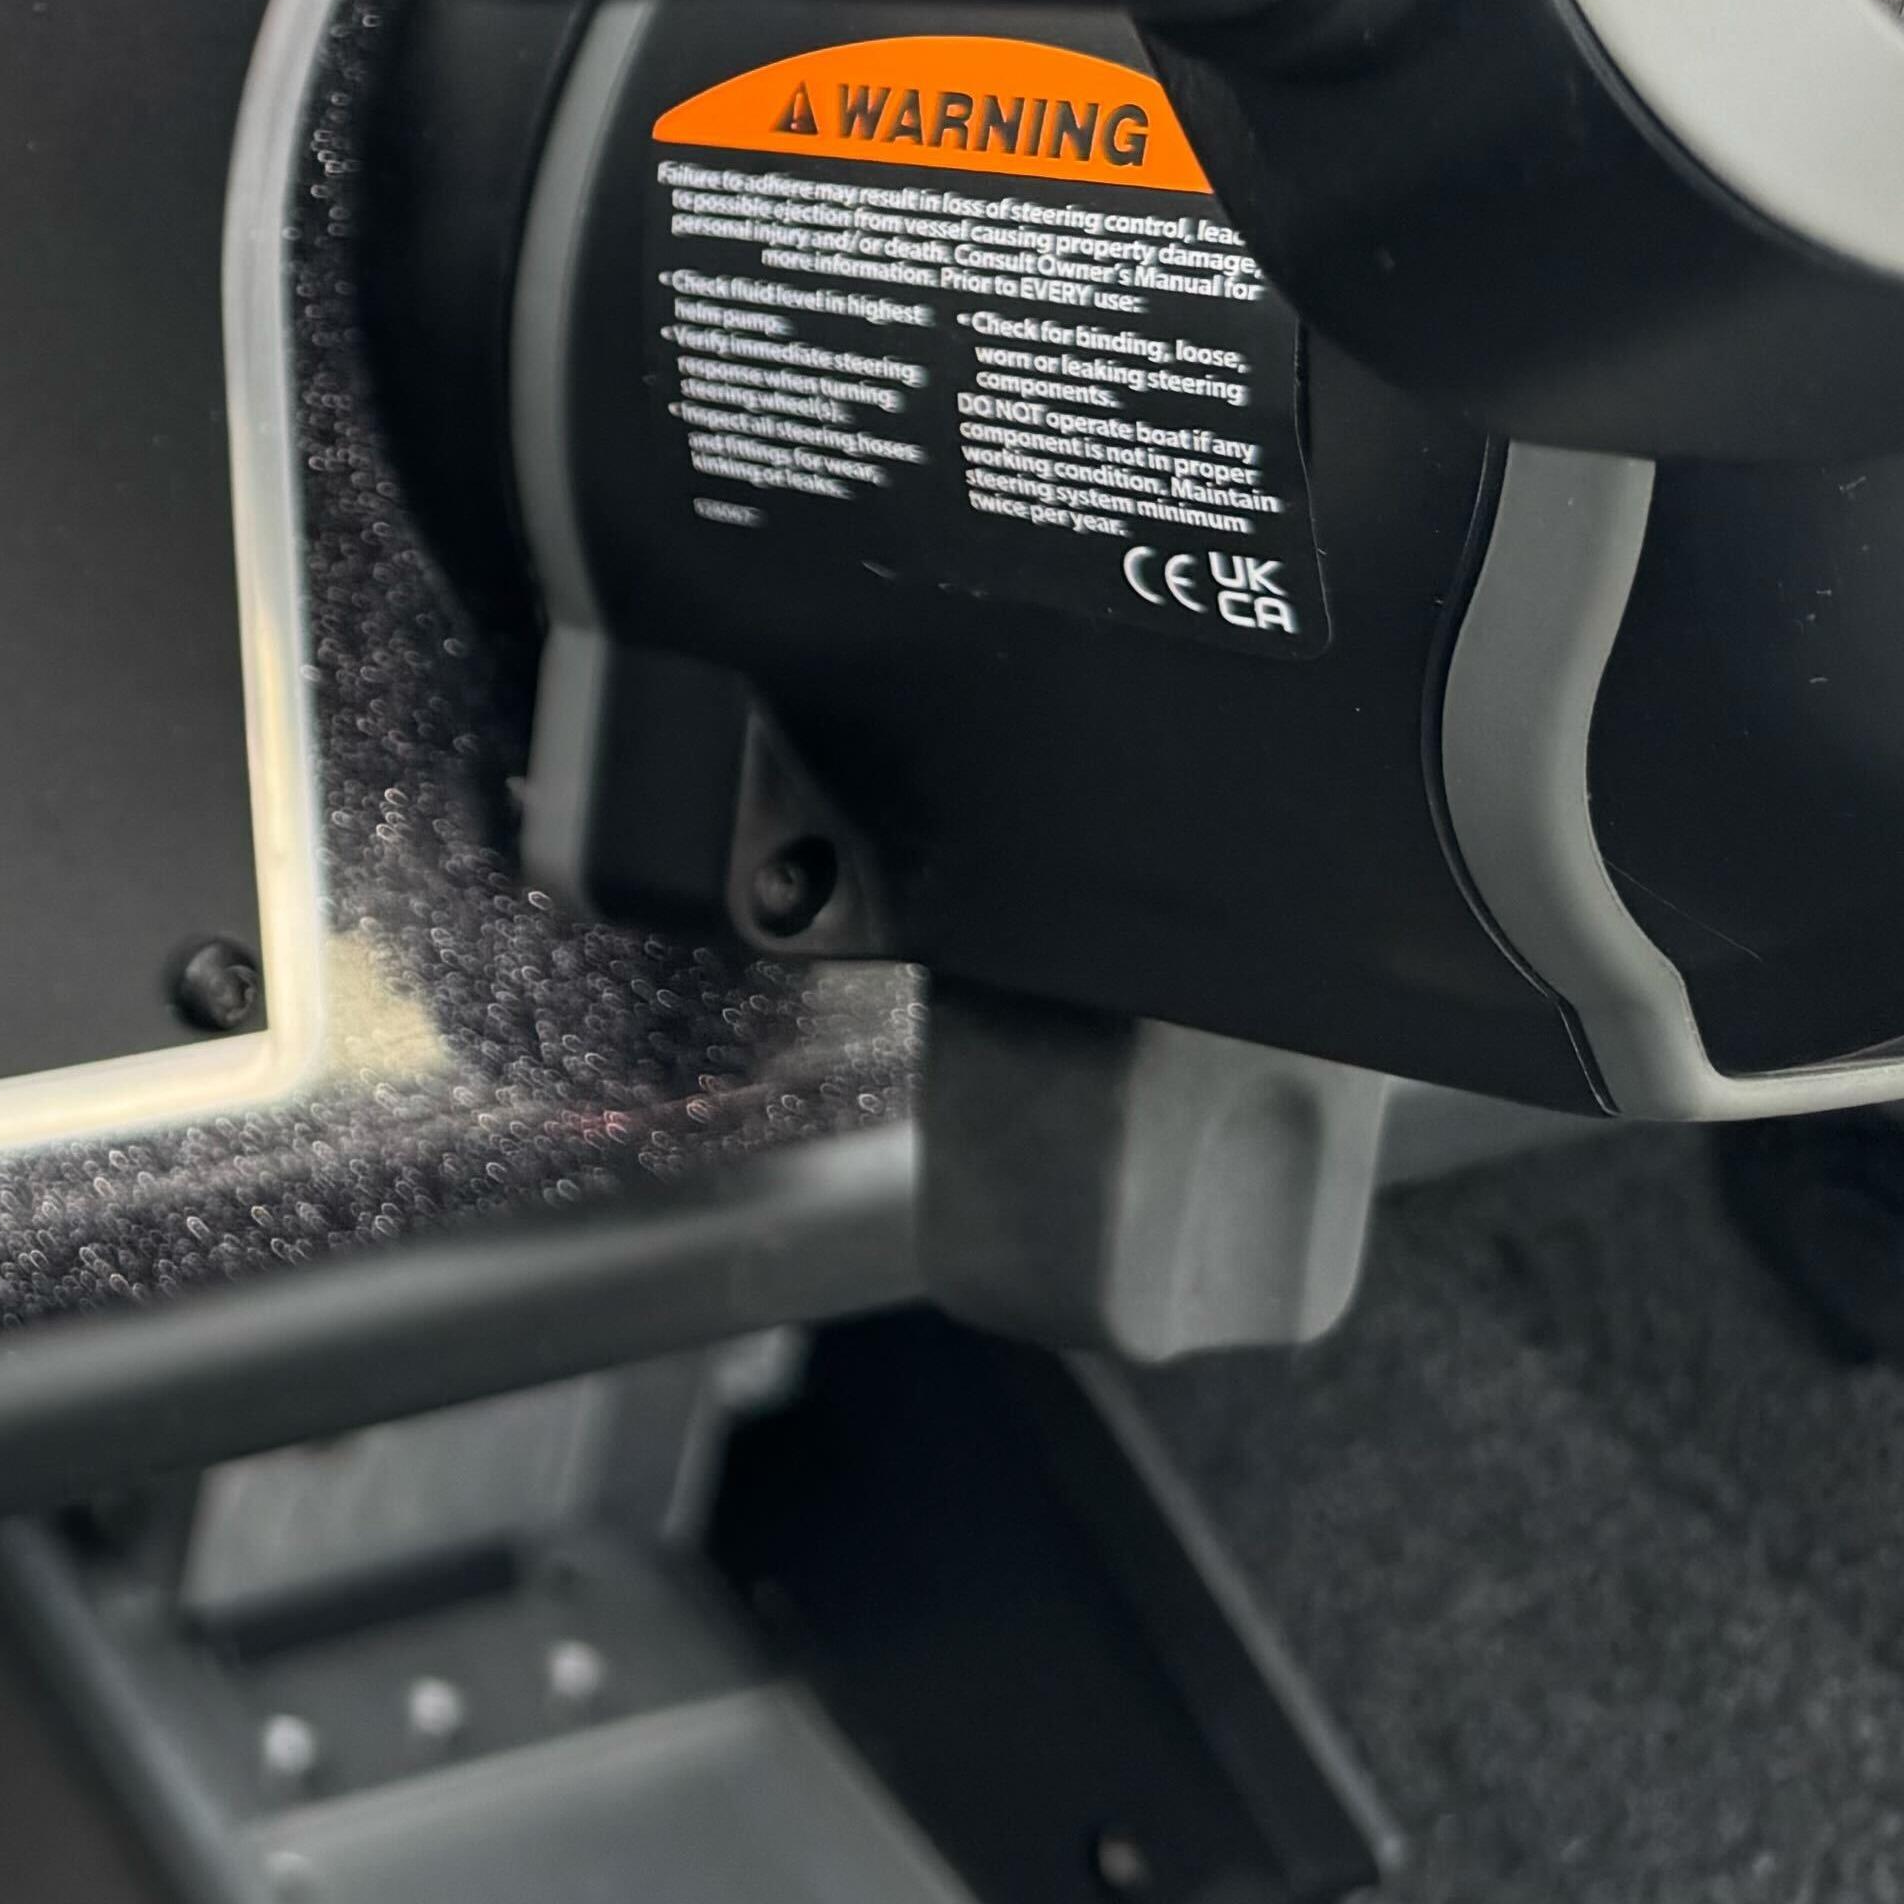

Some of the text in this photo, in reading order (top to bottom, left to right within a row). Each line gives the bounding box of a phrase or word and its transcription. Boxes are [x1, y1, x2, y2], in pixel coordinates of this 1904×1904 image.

[835, 83, 1150, 168] WARNING
[658, 160, 722, 190] Failure
[723, 170, 743, 192] to
[744, 172, 814, 198] adhere
[815, 183, 858, 207] may
[860, 186, 919, 211] result
[920, 189, 942, 212] in
[943, 192, 986, 218] loss
[986, 198, 1011, 220] of
[1012, 203, 1104, 235] steering
[1105, 213, 1192, 243] control,
[672, 189, 1263, 279] to possible ejection from vessel causing property damage,
[671, 213, 752, 241] personal
[753, 221, 811, 249] injury
[884, 235, 953, 264] death.
[954, 244, 1036, 274] Consult
[1134, 266, 1223, 298] Manual
[1224, 276, 1266, 301] for
[761, 248, 1150, 313] more information. Prior to EVERY use:
[972, 311, 1040, 340] Check
[1041, 320, 1075, 344] for
[1176, 340, 1251, 373] loose,
[975, 347, 1251, 406] worn or leaking steering
[976, 371, 1126, 409] components.
[957, 393, 1260, 465] DO NOT operate boat if any
[959, 422, 1263, 486] component is not in proper
[961, 445, 1286, 513] working condition. Maintain
[965, 468, 1256, 534] steering system minimum
[968, 490, 1136, 538] twice per year.
[1123, 546, 1208, 614] CE
[1208, 551, 1289, 596] UK
[1217, 590, 1302, 634] CA
